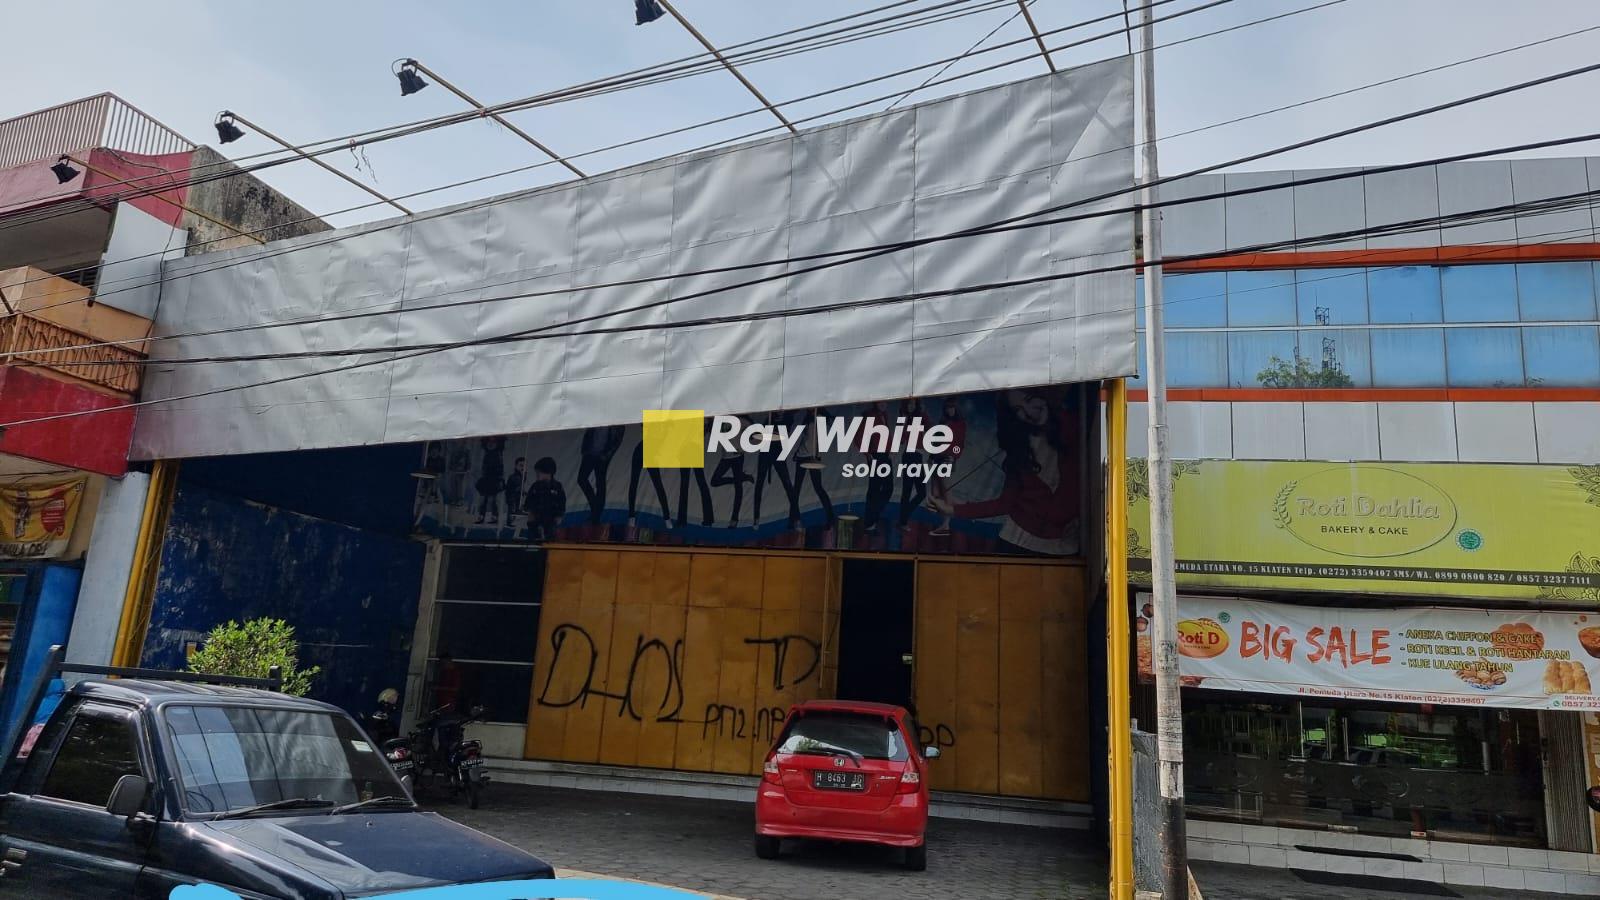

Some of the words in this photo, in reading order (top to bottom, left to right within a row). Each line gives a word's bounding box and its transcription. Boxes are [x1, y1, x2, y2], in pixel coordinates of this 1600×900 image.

[1298, 496, 1347, 517] Roti
[1354, 495, 1440, 520] Dahlia
[1321, 525, 1365, 534] BAKERY
[1368, 526, 1375, 535] &
[1378, 526, 1409, 536] CAKE
[1233, 565, 1246, 573] NO.
[1261, 566, 1292, 575] KLATEN
[1319, 569, 1349, 577] (0272)
[1351, 569, 1391, 578] 3359407
[1435, 572, 1458, 580] 0899
[1461, 573, 1485, 582] 0800
[1488, 574, 1505, 582] 820
[1517, 575, 1540, 584] 0857
[1543, 576, 1568, 585] 3237
[1571, 577, 1591, 586] 7111
[1177, 630, 1204, 645] Roti
[1208, 632, 1220, 645] D
[1406, 629, 1444, 640] ANEKA
[1496, 634, 1506, 644] &
[1508, 635, 1537, 644] CAKE
[1240, 621, 1298, 664] BIG
[1306, 626, 1392, 669] SALE
[1407, 643, 1432, 653] ROTI
[1435, 646, 1465, 656] KECIL
[1467, 647, 1477, 657] &
[1479, 647, 1505, 657] ROTI
[1508, 649, 1571, 660] HANTARAN
[1408, 658, 1431, 668] KUE
[1433, 659, 1472, 670] ULANG
[1475, 661, 1514, 672] TAHUN
[1309, 688, 1342, 696] Pemuda
